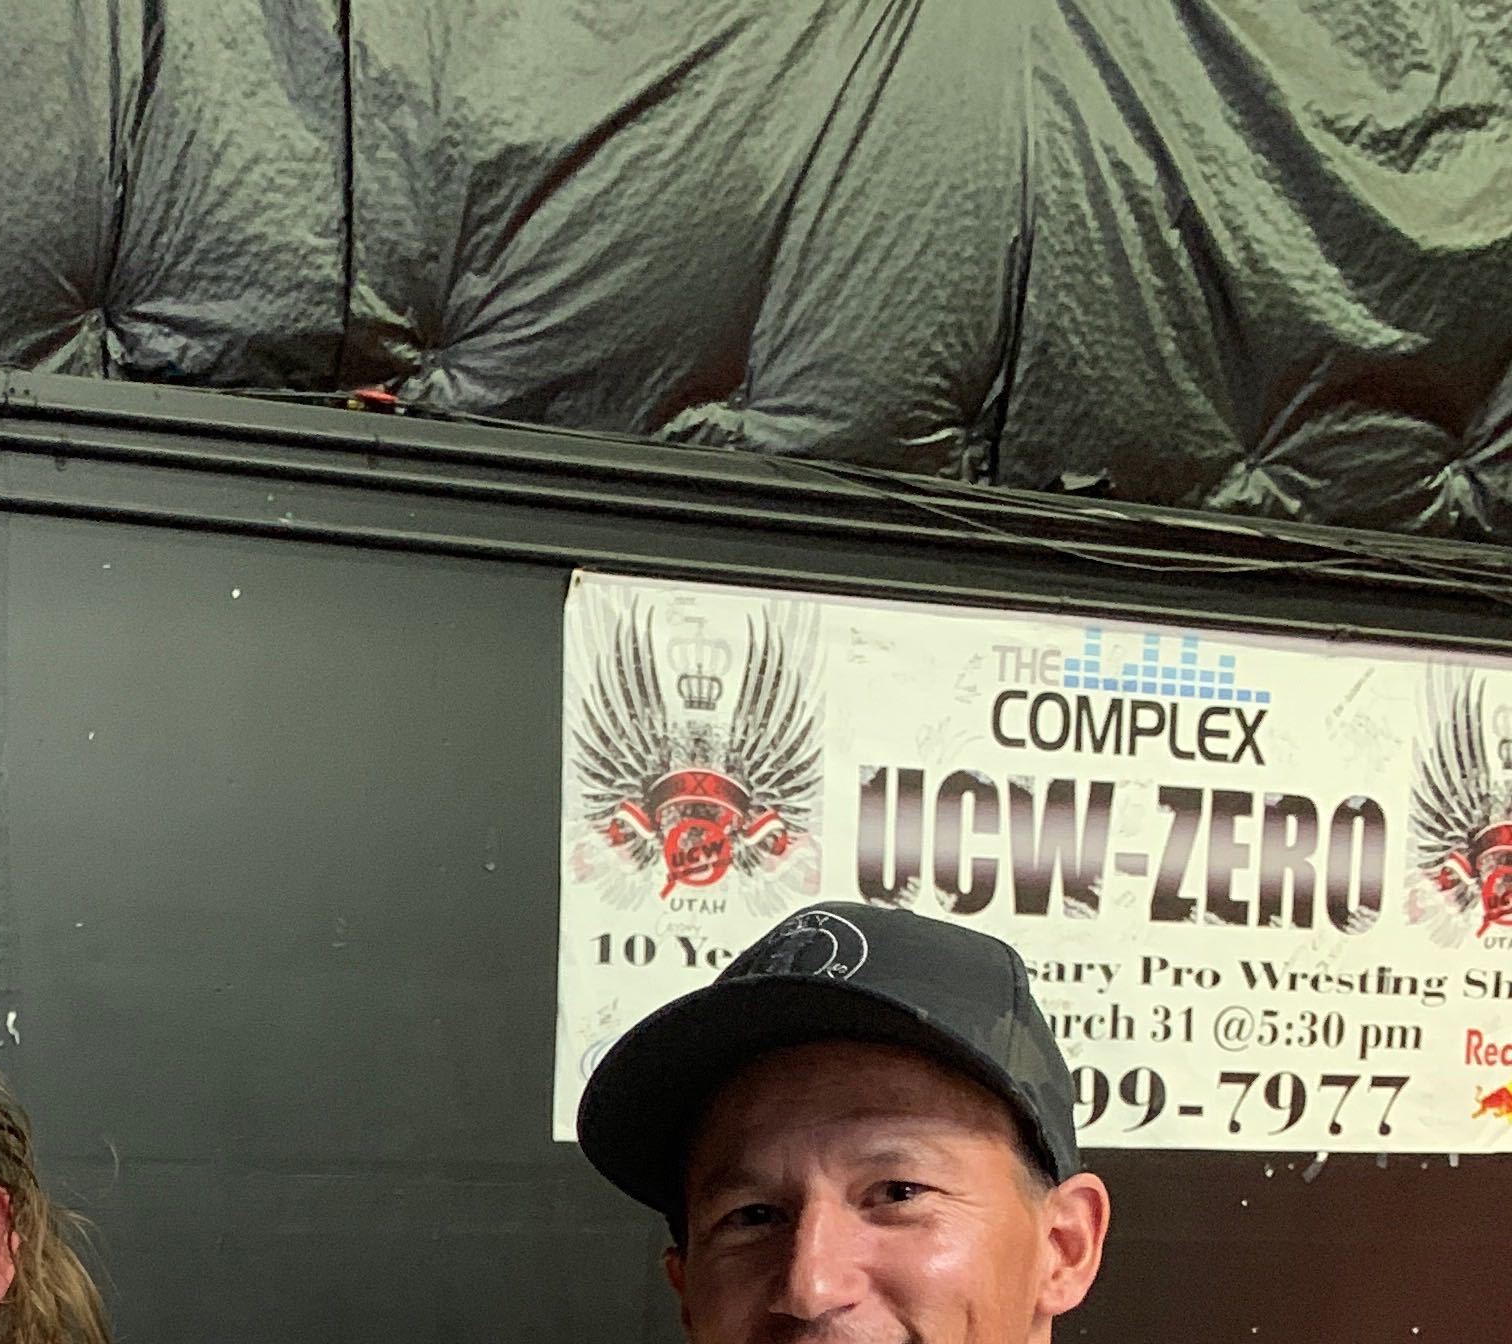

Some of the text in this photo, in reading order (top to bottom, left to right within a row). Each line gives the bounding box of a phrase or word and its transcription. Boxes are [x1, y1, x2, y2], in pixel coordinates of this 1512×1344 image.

[992, 644, 1062, 686] THE
[992, 690, 1268, 766] COMPLEX
[857, 764, 1387, 936] UCW-ZERO
[670, 898, 726, 914] UTAH
[588, 933, 656, 967] 10
[675, 935, 733, 969] Ye
[1139, 954, 1222, 990] Pro
[1463, 967, 1512, 1000] Sh
[1483, 936, 1512, 950] UT
[1151, 1005, 1194, 1043] 31
[1213, 1004, 1346, 1053] @5:30
[1358, 1020, 1423, 1060] pm
[1071, 1065, 1411, 1137] 99-7977
